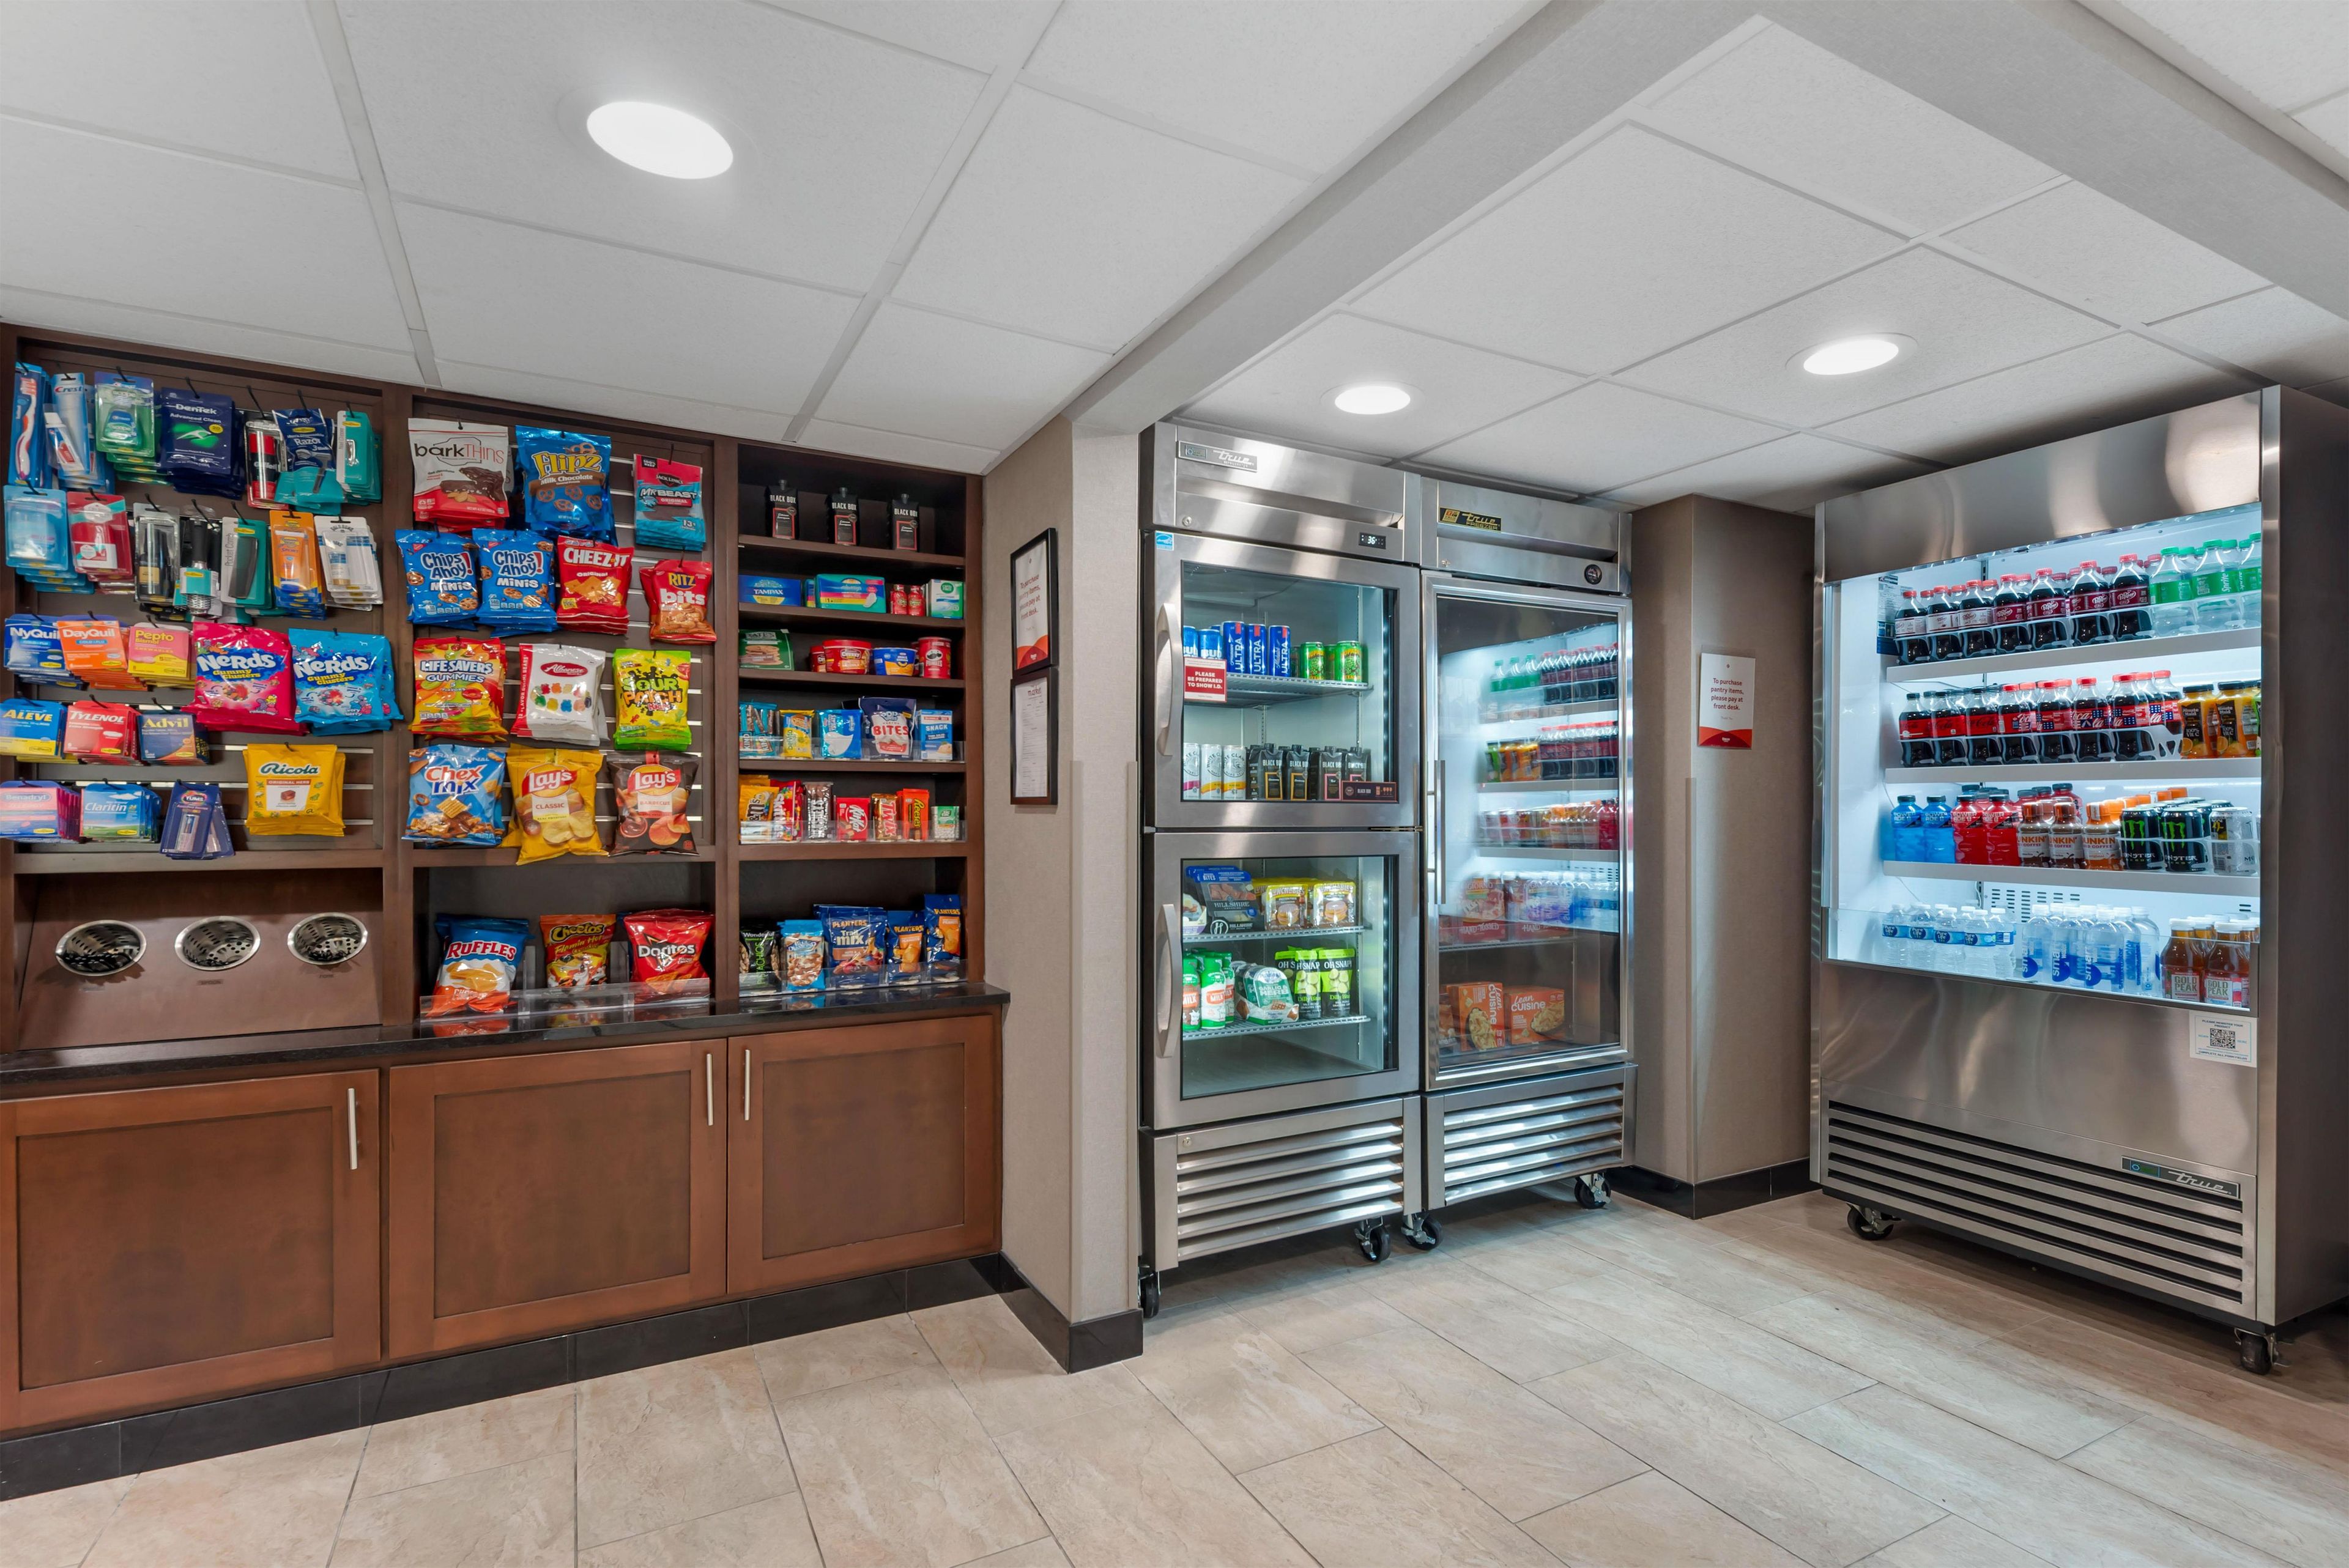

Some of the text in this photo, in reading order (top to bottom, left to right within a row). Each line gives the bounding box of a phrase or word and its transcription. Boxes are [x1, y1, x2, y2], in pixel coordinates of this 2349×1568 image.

[176, 404, 217, 415] DenTek
[533, 451, 601, 479] Flipz
[1462, 513, 1498, 525] true
[226, 533, 235, 549] Comb
[422, 553, 462, 569] Chips
[494, 550, 534, 566] Chips
[669, 573, 696, 586] RITZ
[659, 589, 705, 605] bits
[63, 629, 115, 638] DayQuil
[135, 630, 174, 642] Pepto
[421, 660, 492, 674] LIFE SAVERS
[546, 664, 585, 674] Albanese
[307, 673, 346, 682] Gummy
[317, 676, 355, 685] Clusters
[426, 674, 485, 683] GUMMIES
[623, 678, 677, 690] SOUR
[623, 690, 682, 706] PATCH
[2, 709, 53, 722] ALEVE
[69, 711, 126, 723] TYLENOL
[143, 717, 189, 728] Advil
[873, 725, 908, 735] BITES
[261, 763, 319, 774] Ricola
[426, 764, 487, 781] Chex
[434, 778, 479, 794] mix
[529, 769, 573, 792] Lay's
[635, 772, 677, 793] Lay's
[84, 802, 127, 812] Claritin
[881, 802, 897, 837] TWIX
[552, 923, 604, 941] Cheetos
[837, 935, 864, 945] mix
[447, 942, 516, 960] RUFFLES
[639, 945, 695, 957] Doritos
[1514, 995, 1534, 1004] Lean
[2168, 1170, 2232, 1194] true
